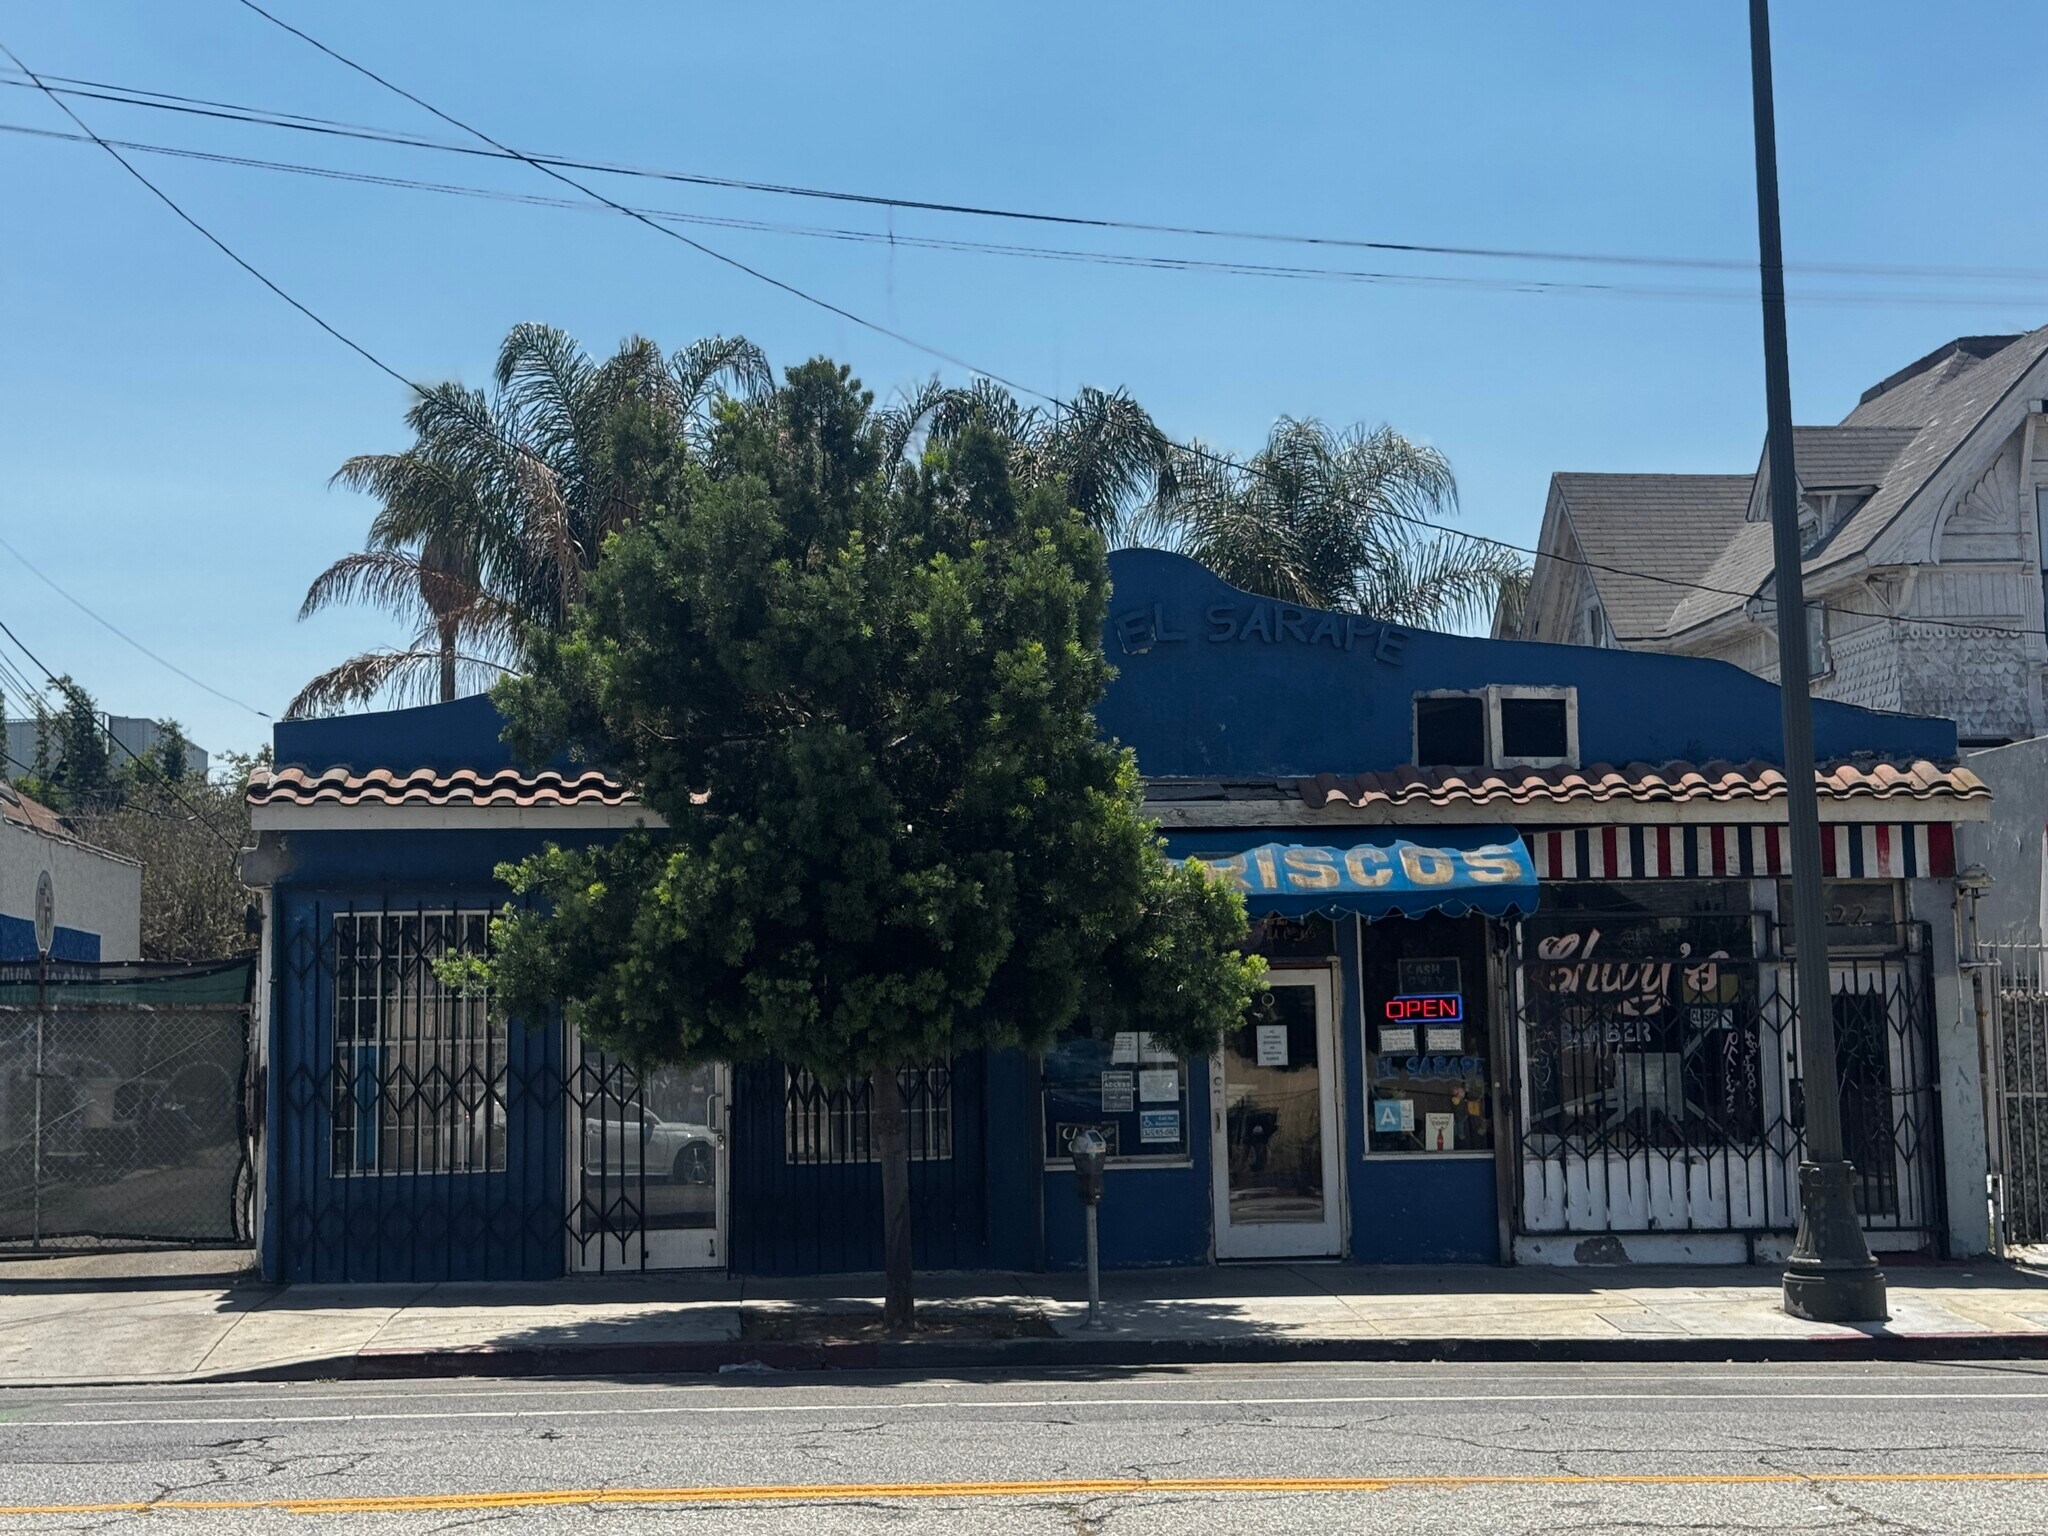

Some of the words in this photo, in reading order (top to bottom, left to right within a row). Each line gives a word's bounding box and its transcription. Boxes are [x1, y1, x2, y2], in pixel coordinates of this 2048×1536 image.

[1115, 602, 1188, 655] EL
[1205, 602, 1410, 668] SARAPE
[1191, 845, 1521, 890] RISCOS
[1406, 964, 1441, 976] CASH
[1386, 999, 1457, 1019] OPEN
[1561, 1020, 1652, 1043] BARBER
[1380, 1107, 1397, 1125] A
